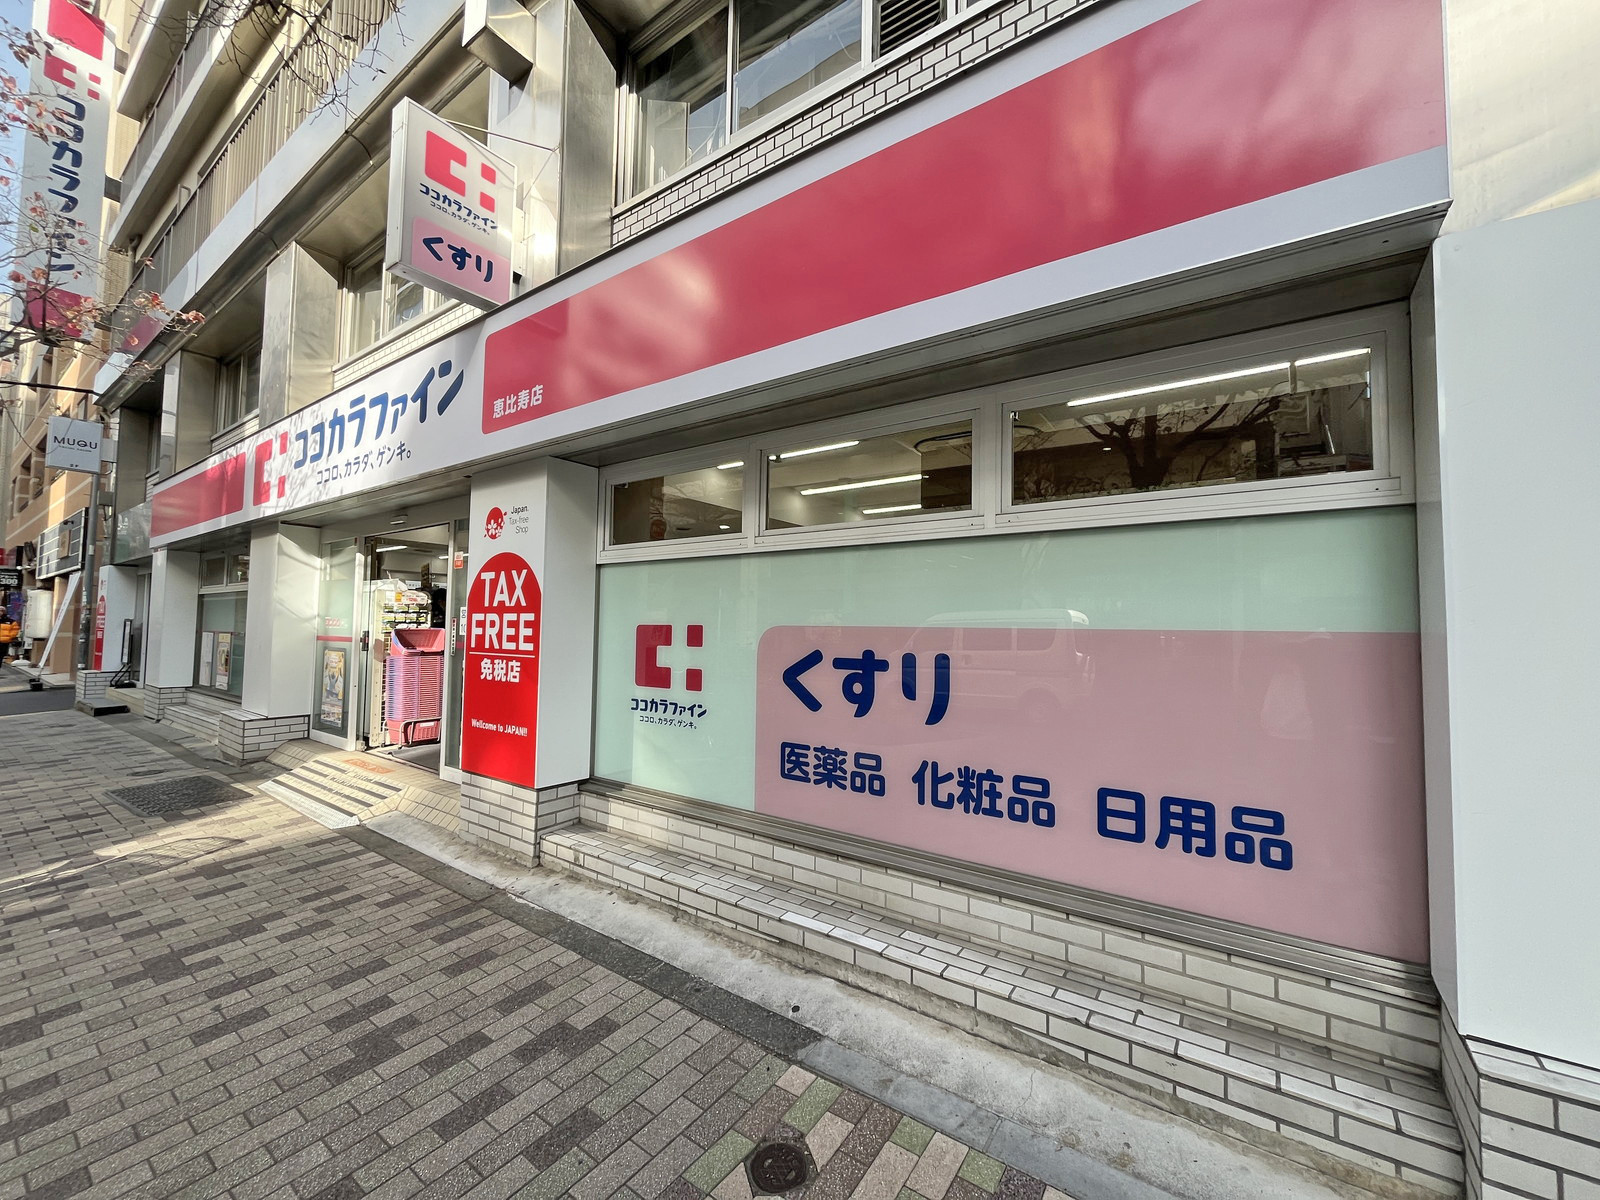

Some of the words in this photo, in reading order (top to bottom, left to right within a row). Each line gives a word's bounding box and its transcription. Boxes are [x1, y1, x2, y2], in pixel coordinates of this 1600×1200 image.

[419, 182, 498, 230] ココカラファイン
[422, 236, 494, 283] くすり
[293, 359, 465, 470] ココカラファイン
[492, 384, 544, 420] 恵比寿店
[53, 435, 98, 450] MUGU
[509, 516, 529, 525] Tax-free
[515, 526, 529, 534] Shop
[480, 568, 528, 607] TAX
[470, 612, 536, 652] FREE
[480, 657, 521, 684] 免税店
[782, 648, 952, 727] くすり
[631, 698, 708, 718] ココカラファイン
[497, 724, 504, 733] to
[780, 740, 886, 797] 医薬品
[911, 759, 1057, 828] 化粧品
[1097, 785, 1294, 872] 日用品
